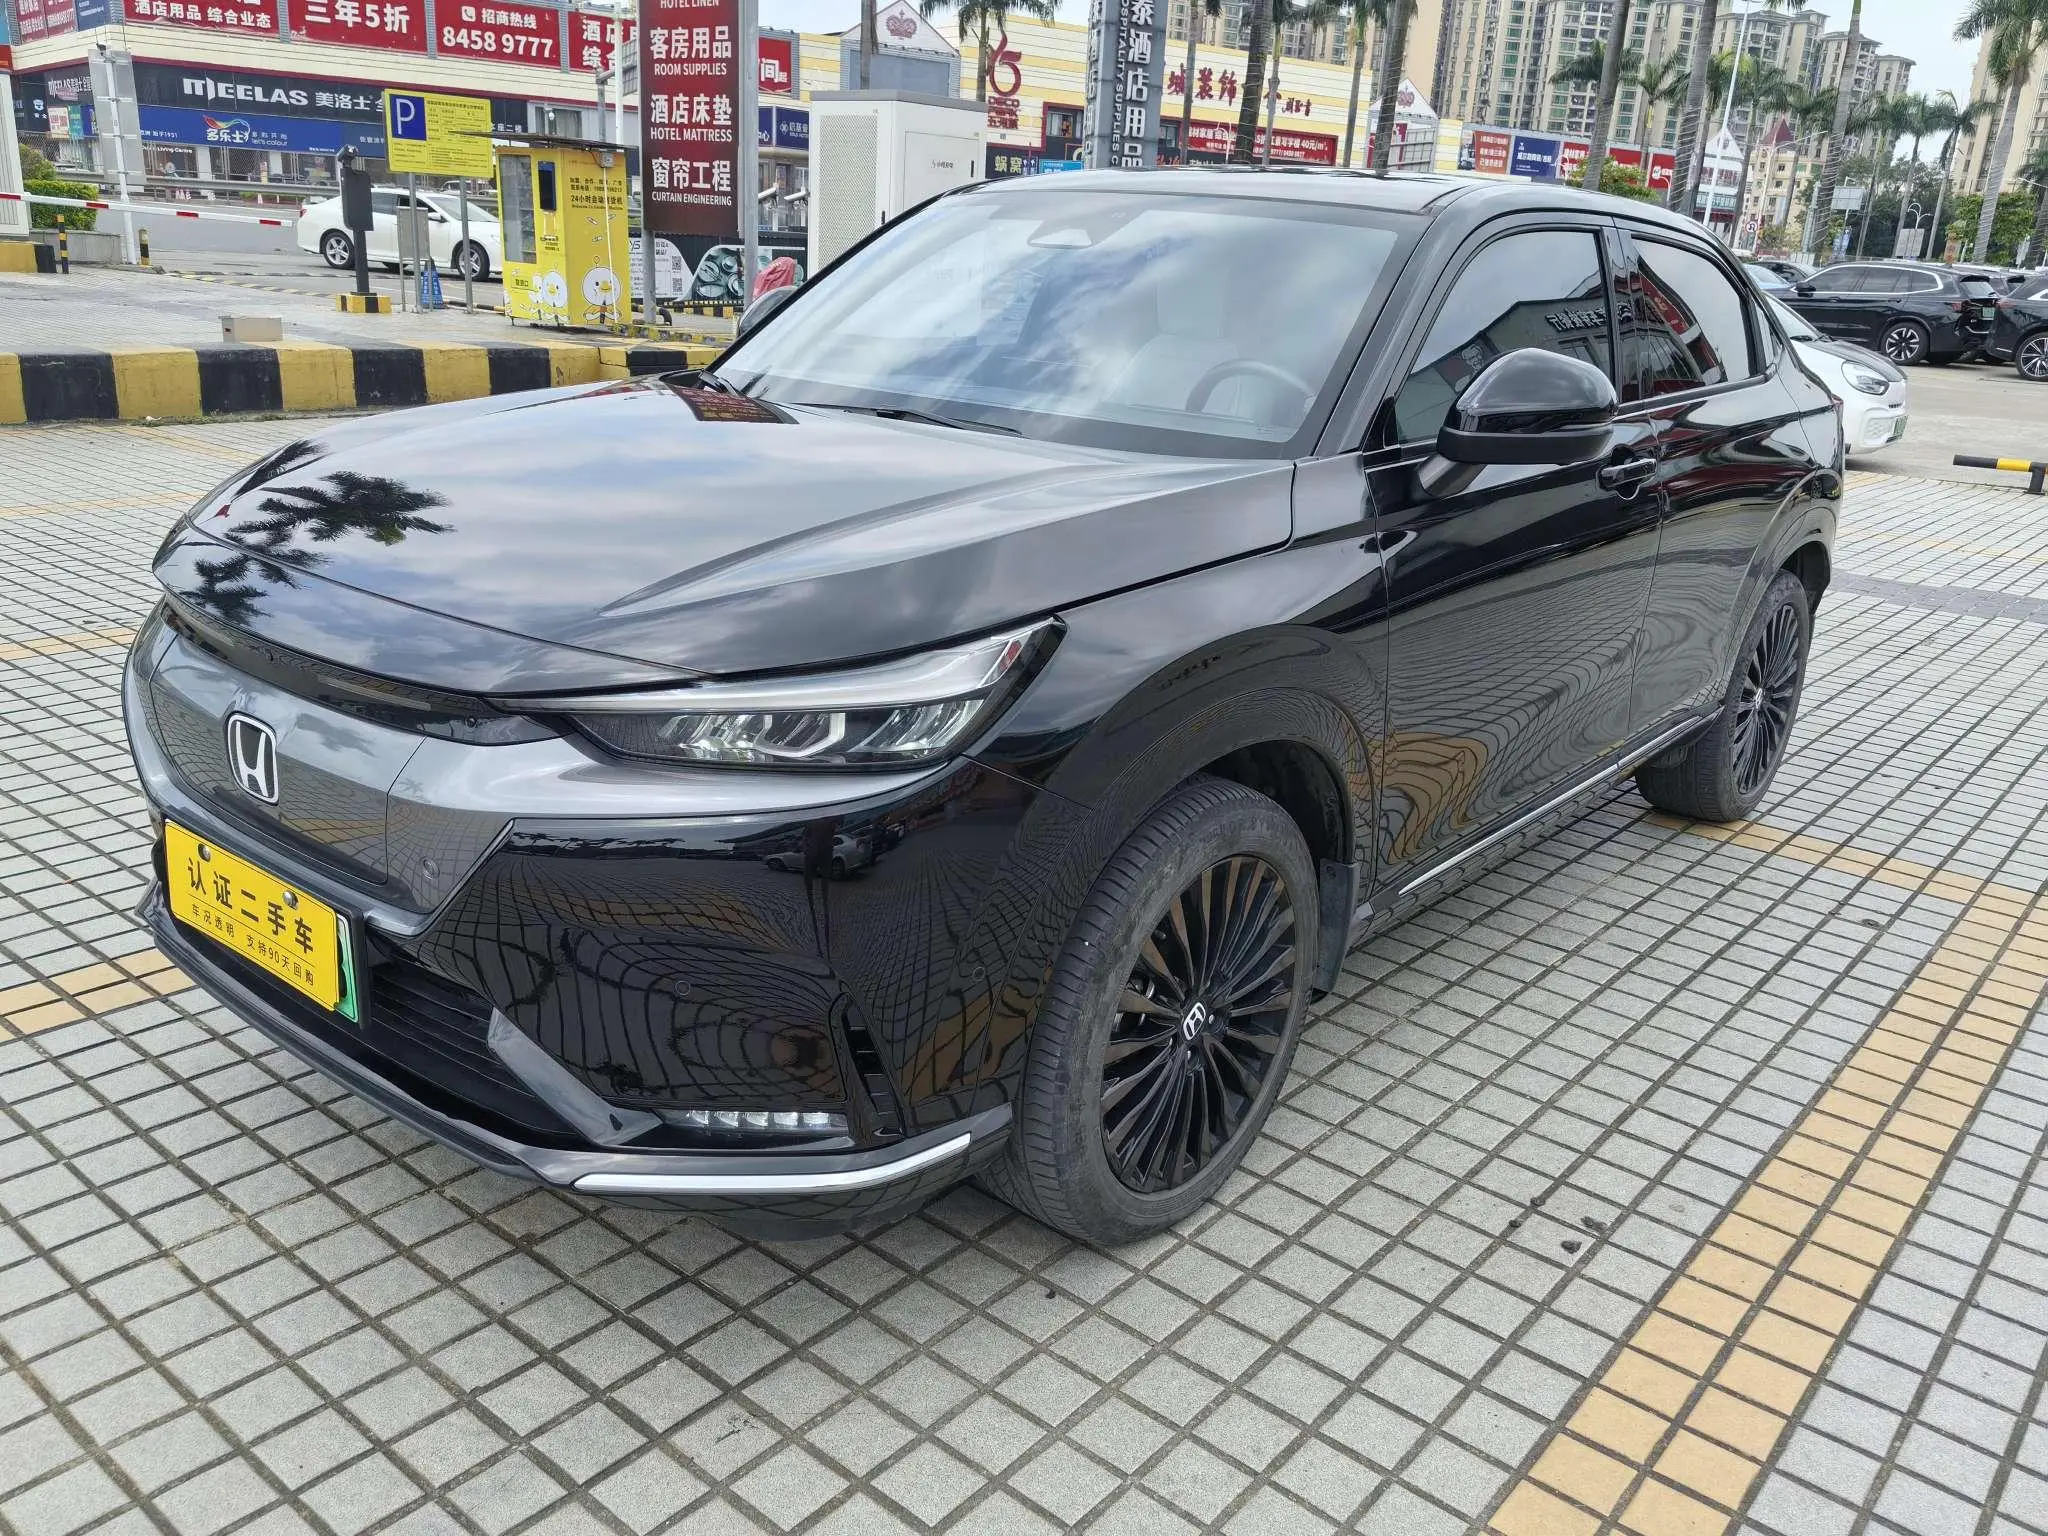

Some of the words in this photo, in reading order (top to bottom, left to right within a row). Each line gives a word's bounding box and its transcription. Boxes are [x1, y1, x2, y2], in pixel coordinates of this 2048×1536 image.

[134, 1, 202, 21] 酒店用品
[207, 6, 272, 29] 综合业态
[305, 0, 410, 34] 三年5折
[481, 7, 537, 30] 招商热线
[660, 0, 689, 8] HOTEL
[442, 26, 497, 52] 8458
[502, 33, 553, 58] 9777
[650, 25, 732, 60] 客房用品
[654, 63, 681, 75] ROOM
[683, 63, 727, 76] SUPPLIES
[315, 91, 371, 111] 美洛士
[395, 98, 415, 135] P
[650, 94, 732, 126] 酒店床垫
[1112, 83, 1124, 151] SUPPLIES
[206, 128, 249, 143] 多乐士
[650, 128, 681, 141] HOTEL
[683, 129, 732, 142] MATTRESS
[651, 158, 732, 192] 窗帘工程
[651, 192, 682, 204] CURTAIN
[683, 194, 732, 206] ENGINEERING
[187, 856, 314, 955] 认证二手车
[191, 904, 235, 939] 车况透明
[246, 934, 315, 987] 支持90天回购
